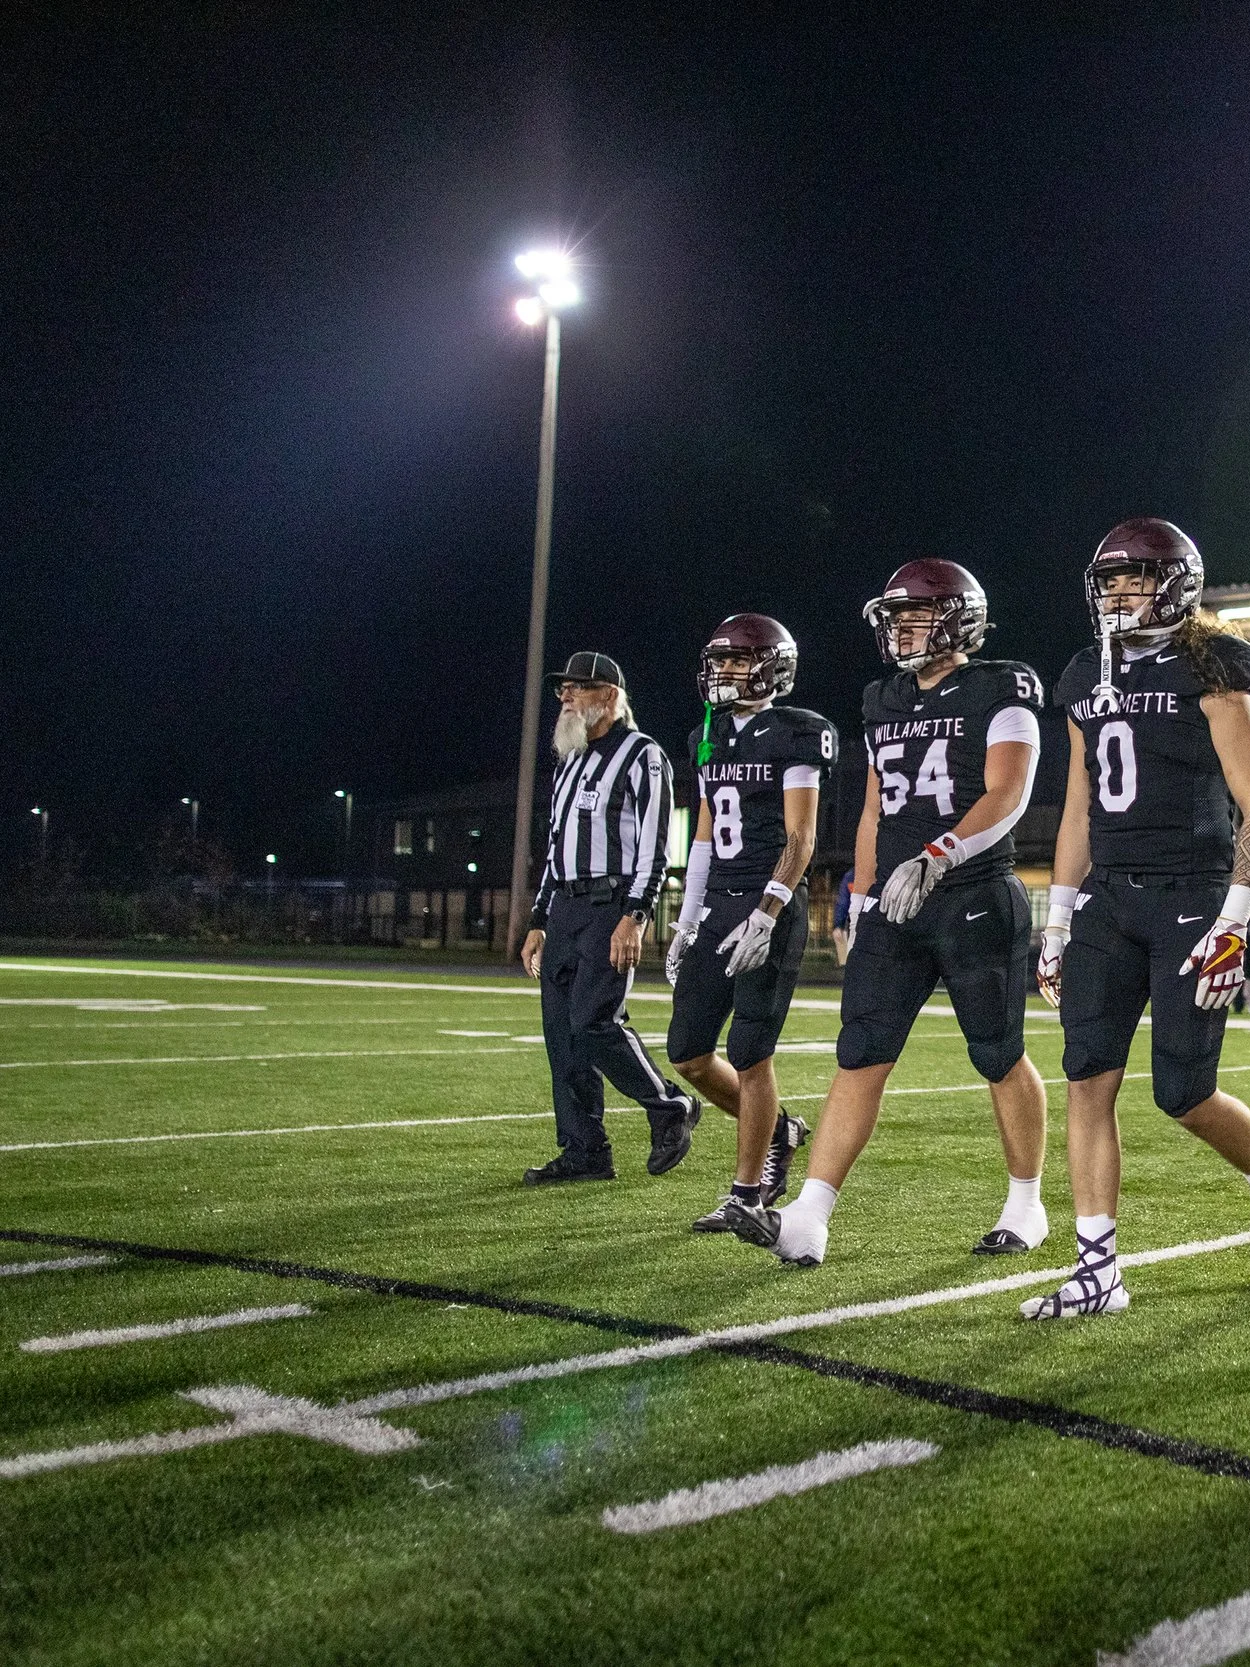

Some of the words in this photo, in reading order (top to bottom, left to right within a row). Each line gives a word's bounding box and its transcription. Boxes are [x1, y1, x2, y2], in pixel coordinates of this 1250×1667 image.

[1013, 671, 1045, 706] 54
[820, 729, 833, 760] 8
[874, 717, 965, 744] WILLAMETTE
[876, 738, 954, 817] 54
[1097, 720, 1137, 812] 0
[713, 785, 744, 860] 8
[787, 1120, 799, 1149] NIKE
